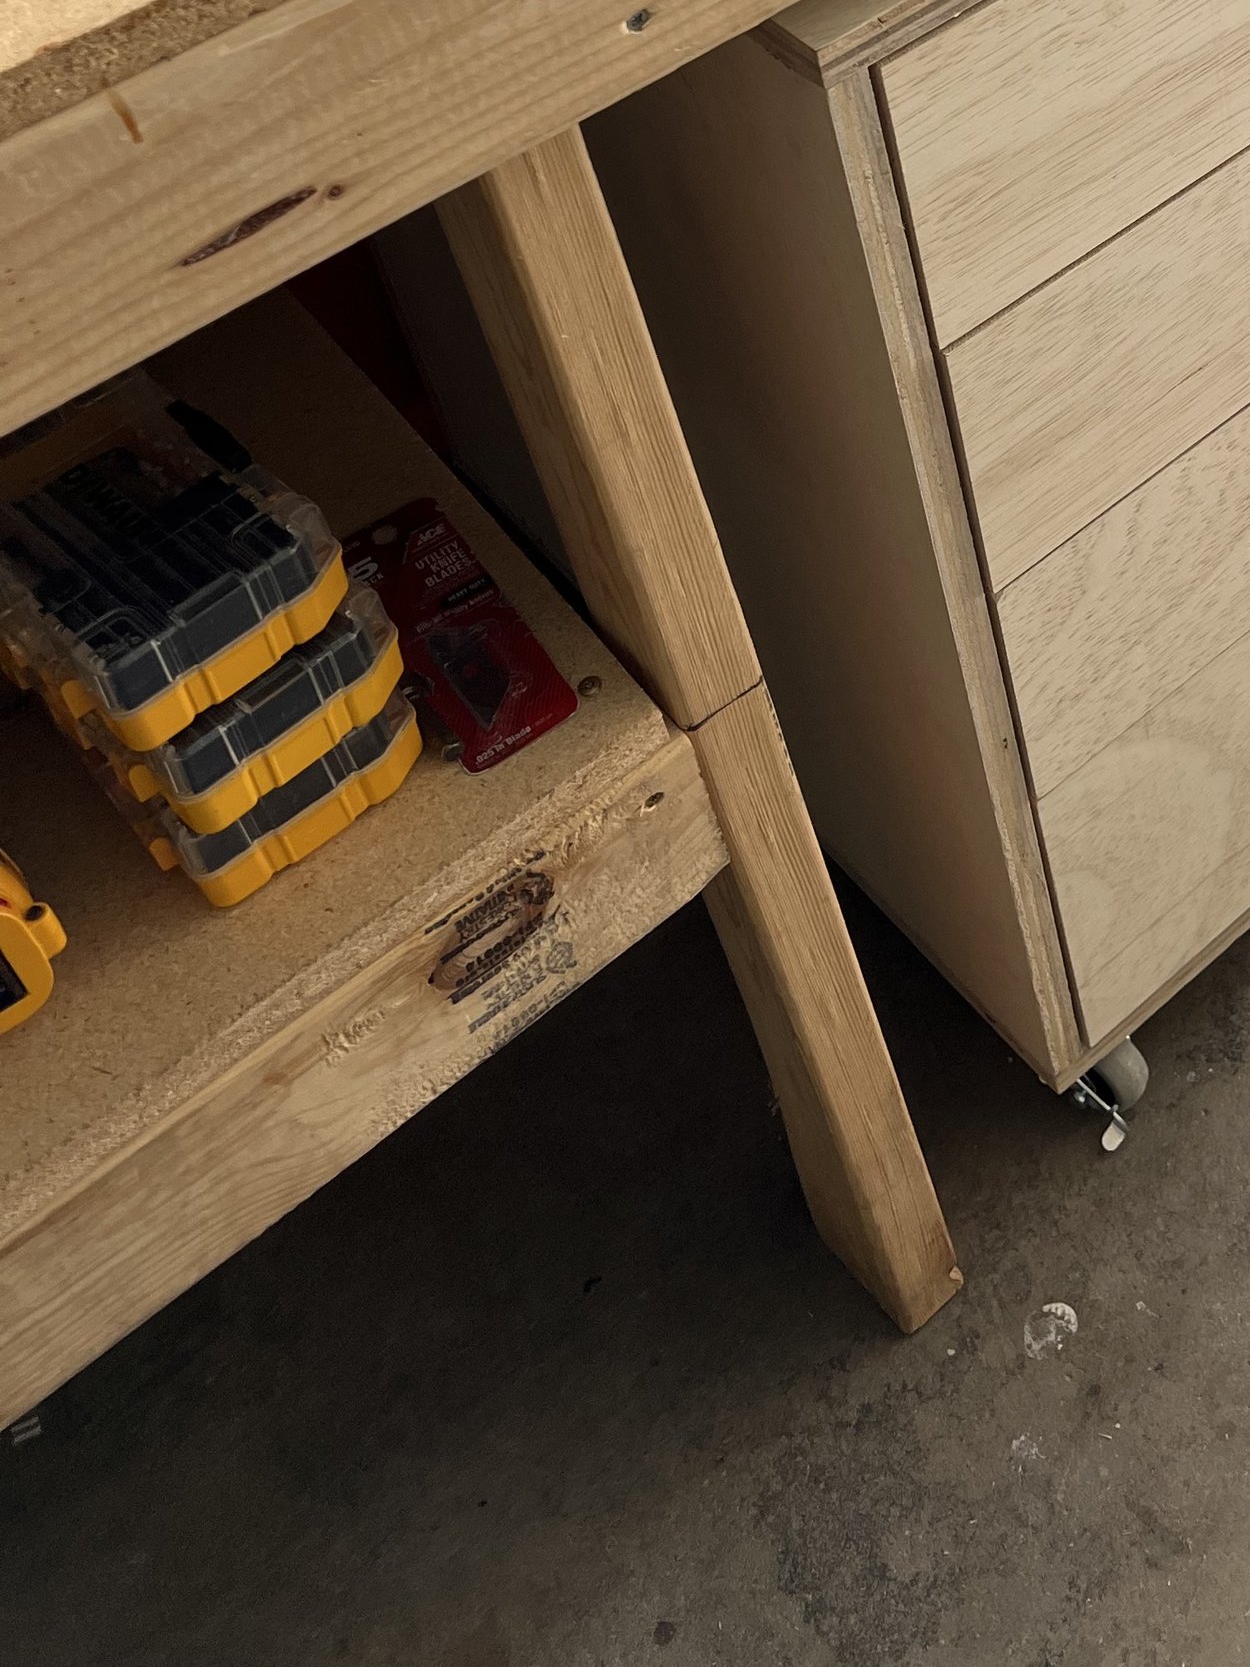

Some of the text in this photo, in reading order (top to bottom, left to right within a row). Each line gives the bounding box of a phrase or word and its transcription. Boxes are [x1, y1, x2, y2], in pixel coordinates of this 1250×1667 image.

[417, 523, 447, 546] ACE
[349, 556, 379, 581] 5
[414, 539, 460, 571] UTILITY
[429, 547, 468, 574] KNIFE
[424, 557, 473, 588] BLADES
